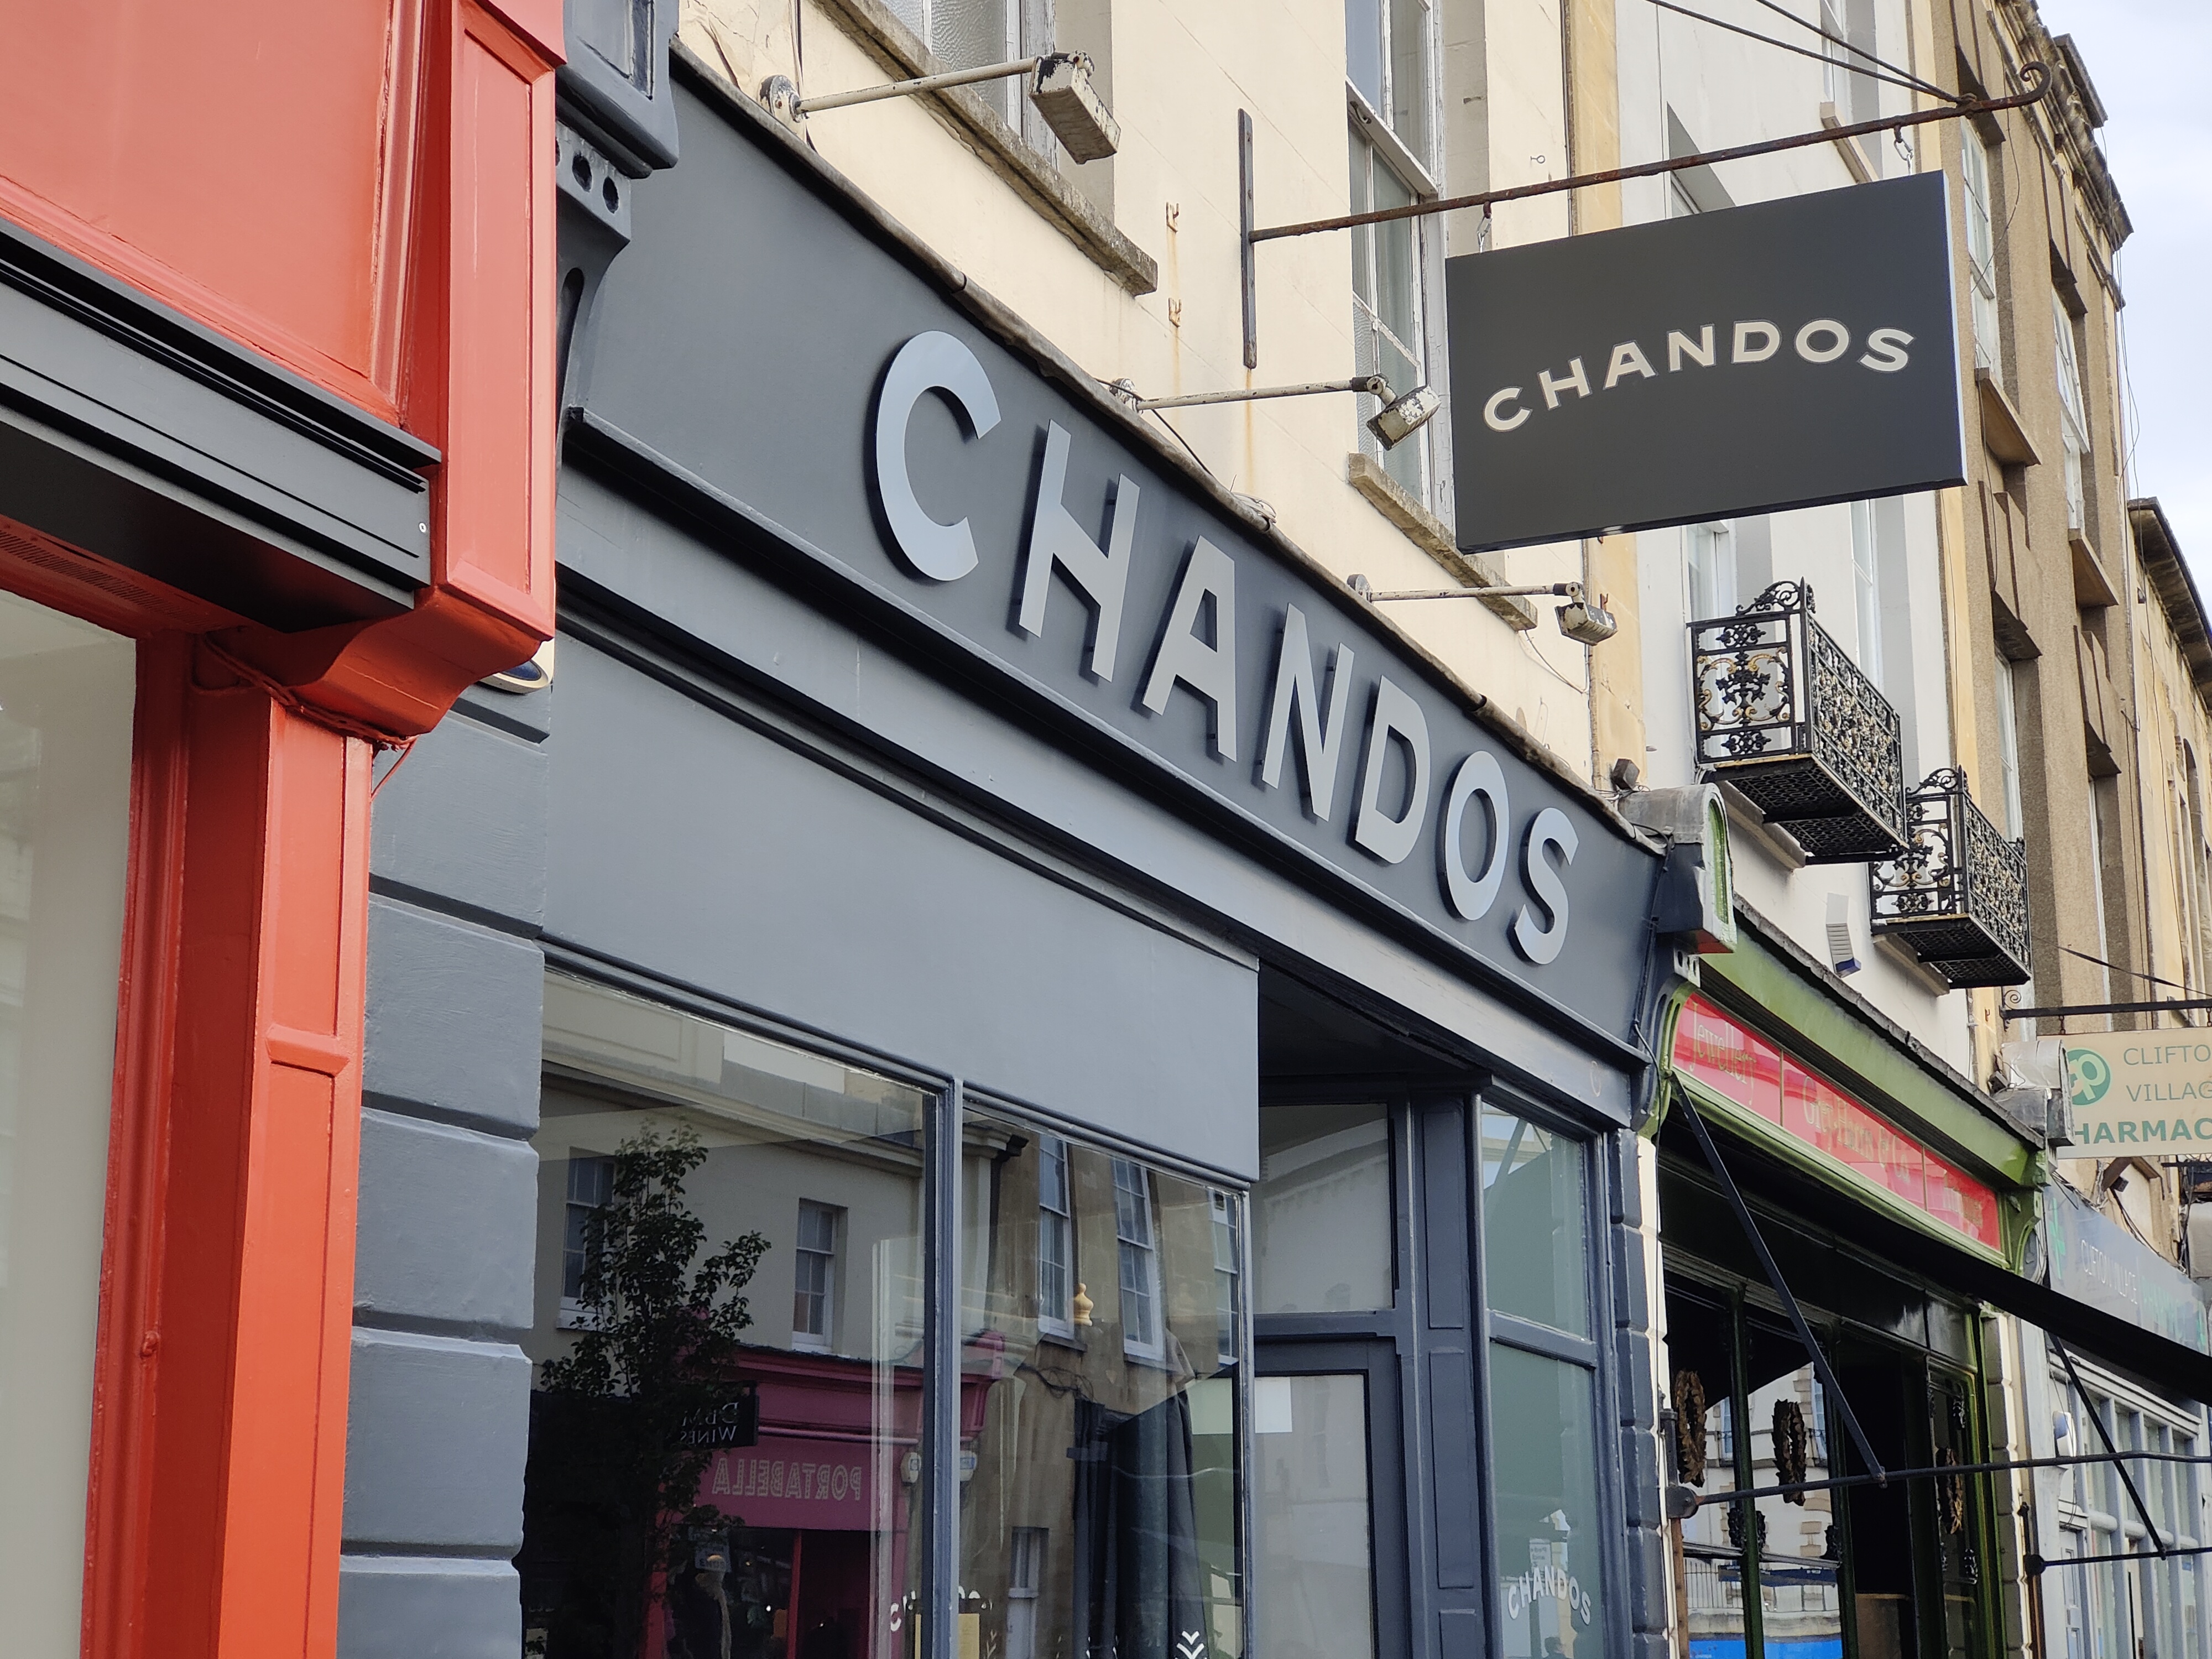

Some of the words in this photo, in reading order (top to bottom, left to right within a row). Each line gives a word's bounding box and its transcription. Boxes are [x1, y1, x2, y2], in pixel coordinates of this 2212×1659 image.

[1483, 317, 1916, 432] CHANDOS
[875, 330, 1579, 964] CHANDOS
[1689, 1001, 1757, 1106] Jewellery
[2124, 1044, 2211, 1066] CLIFTO
[2126, 1081, 2212, 1102] VILLAG
[1507, 1565, 1591, 1625] CHANDOS
